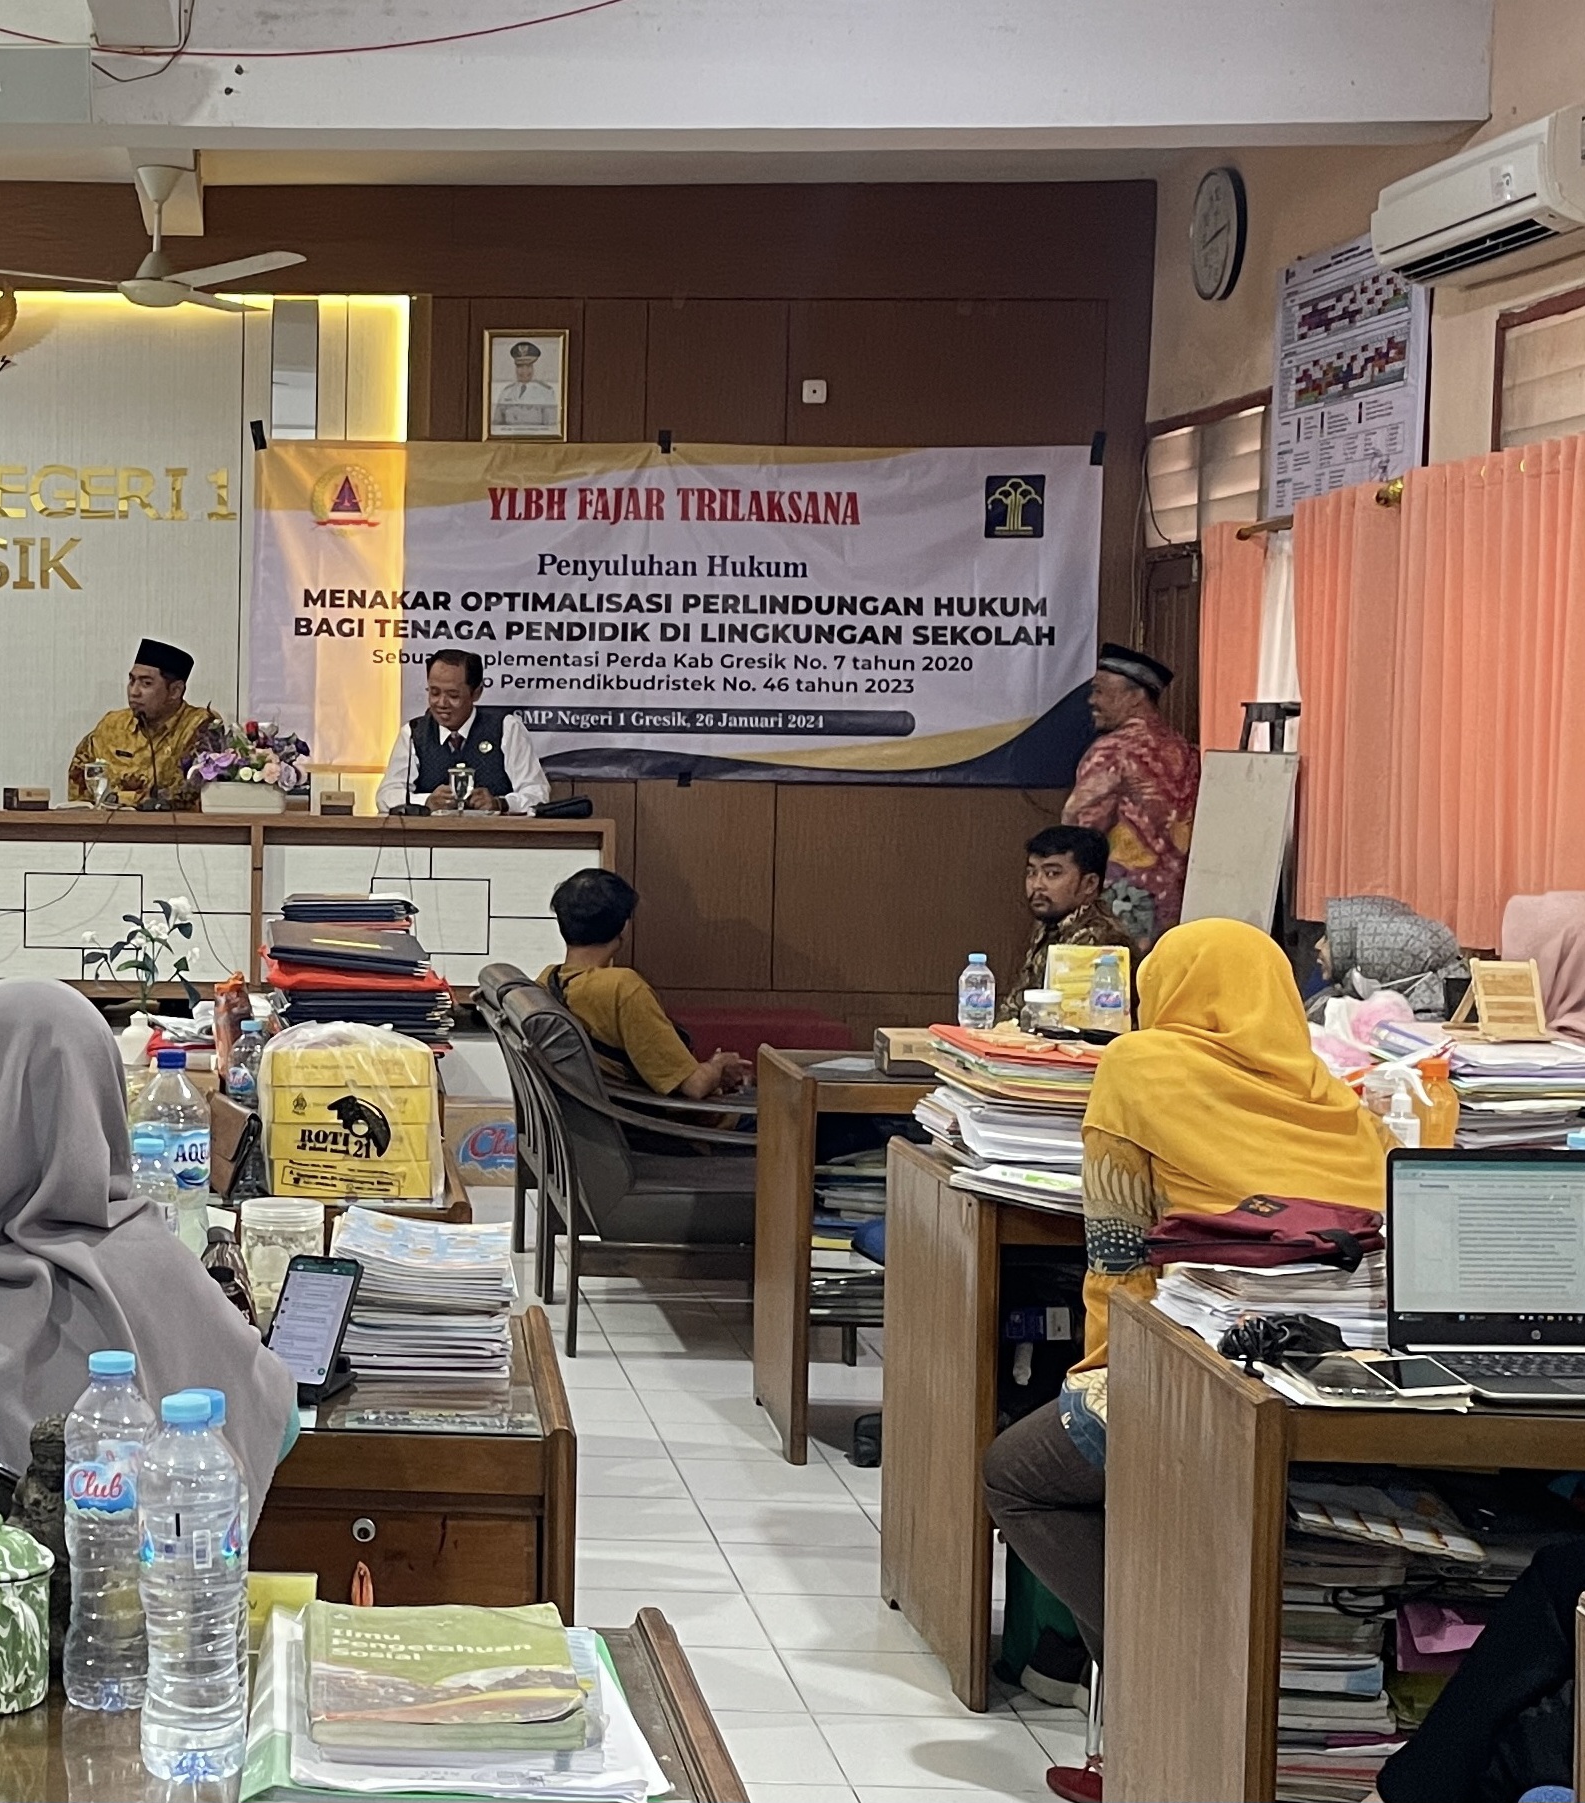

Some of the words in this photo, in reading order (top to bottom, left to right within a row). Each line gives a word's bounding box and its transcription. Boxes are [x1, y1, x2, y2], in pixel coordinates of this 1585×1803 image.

[206, 467, 238, 522] 1
[488, 487, 568, 522] YLBH
[576, 487, 665, 526] FAJAR
[676, 488, 861, 526] TRILAKSANA
[536, 553, 698, 582] Penyuluhan
[707, 554, 809, 579] Hukum
[303, 588, 451, 613] MENAKAR
[460, 590, 673, 614] OPTIMALISASI
[682, 593, 925, 617] PERLINDUNGAN
[934, 596, 1048, 617] HUKUM
[294, 617, 365, 639] BAGI
[374, 618, 497, 641] TENAGA
[505, 621, 651, 643] PENDIDIK
[659, 623, 691, 643] DI
[700, 622, 903, 646] LINGKUNGAN
[912, 625, 1056, 647] SEKOLAH
[372, 649, 432, 666] Sebua
[607, 653, 667, 668] Perda
[674, 653, 714, 669] Kab
[720, 653, 787, 670] Gresik
[794, 655, 828, 670] No.
[834, 655, 846, 670] 7
[852, 655, 915, 671] tahun
[921, 656, 974, 672] 2020
[501, 673, 716, 693] Permendikbudristek
[723, 677, 757, 693] No.
[763, 677, 790, 693] 46
[796, 677, 858, 694] tahun
[864, 678, 915, 694] 2023
[513, 710, 554, 726] SMP
[557, 710, 613, 729] Negeri
[618, 712, 626, 727] 1
[631, 711, 691, 728] Gresik,
[695, 713, 714, 727] 26
[717, 712, 783, 728] Januari
[787, 714, 824, 728] 2024
[300, 1129, 350, 1146] ROTI
[353, 1139, 370, 1158] 21
[69, 1469, 123, 1498] Club
[331, 1627, 401, 1641] Ilmu
[331, 1637, 532, 1654] Pengetahuan
[331, 1648, 422, 1662] Sosial
